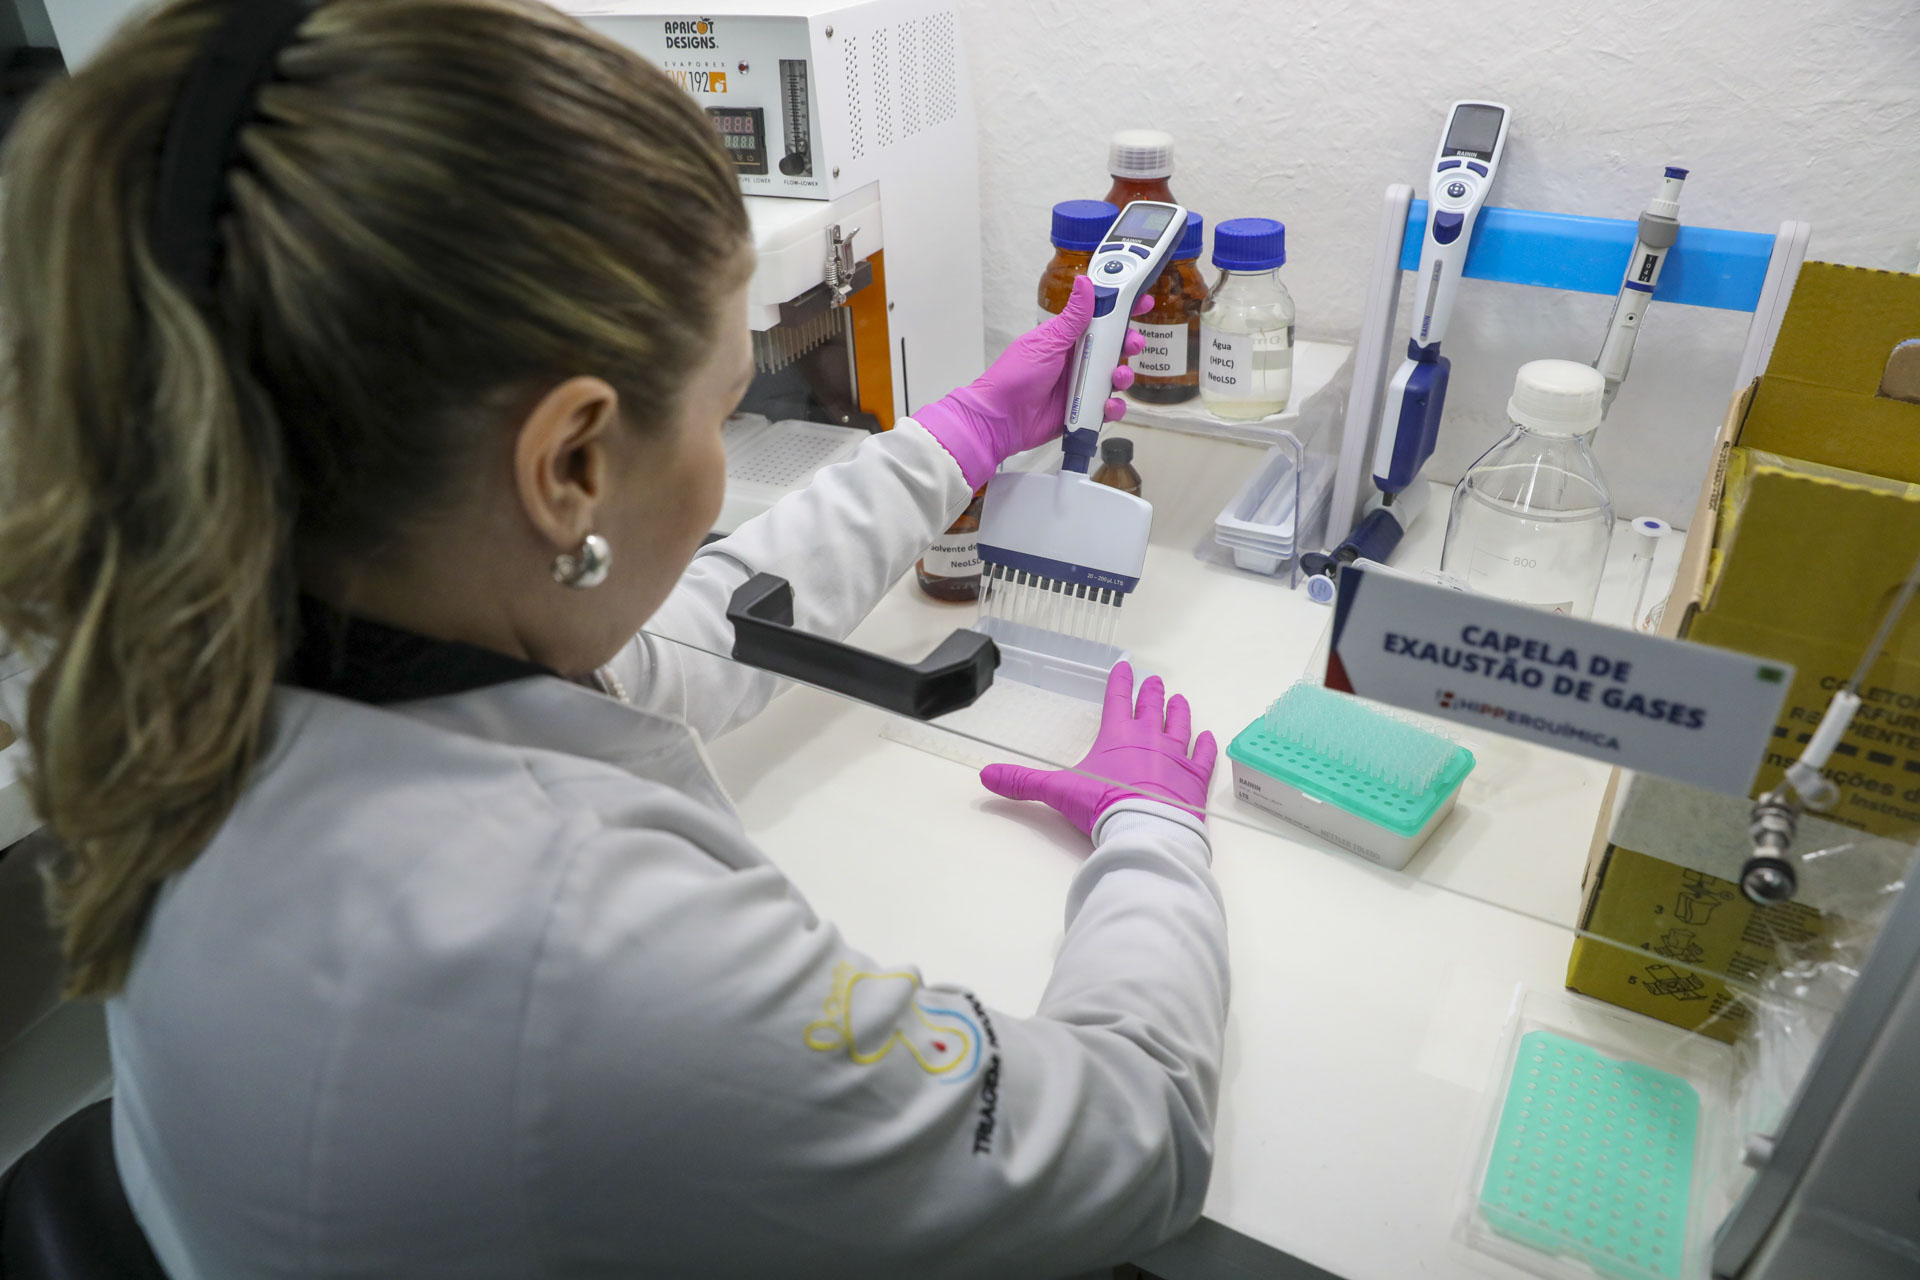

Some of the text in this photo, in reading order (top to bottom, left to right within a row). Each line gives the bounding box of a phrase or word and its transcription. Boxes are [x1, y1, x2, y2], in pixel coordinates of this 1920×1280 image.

[1456, 150, 1478, 158] RAININ
[1139, 328, 1173, 339] Metanol
[1212, 338, 1232, 351] Água
[1139, 361, 1171, 371] NeoLSD
[1209, 355, 1234, 369] (HPLC)
[1208, 371, 1237, 385] NeoLSD
[1513, 556, 1537, 569] 800
[1462, 625, 1632, 684] CAPELA DE
[1383, 632, 1707, 730] EXAUSTÃO DE GASES
[1654, 904, 1664, 915] 3
[1628, 975, 1638, 985] 5
